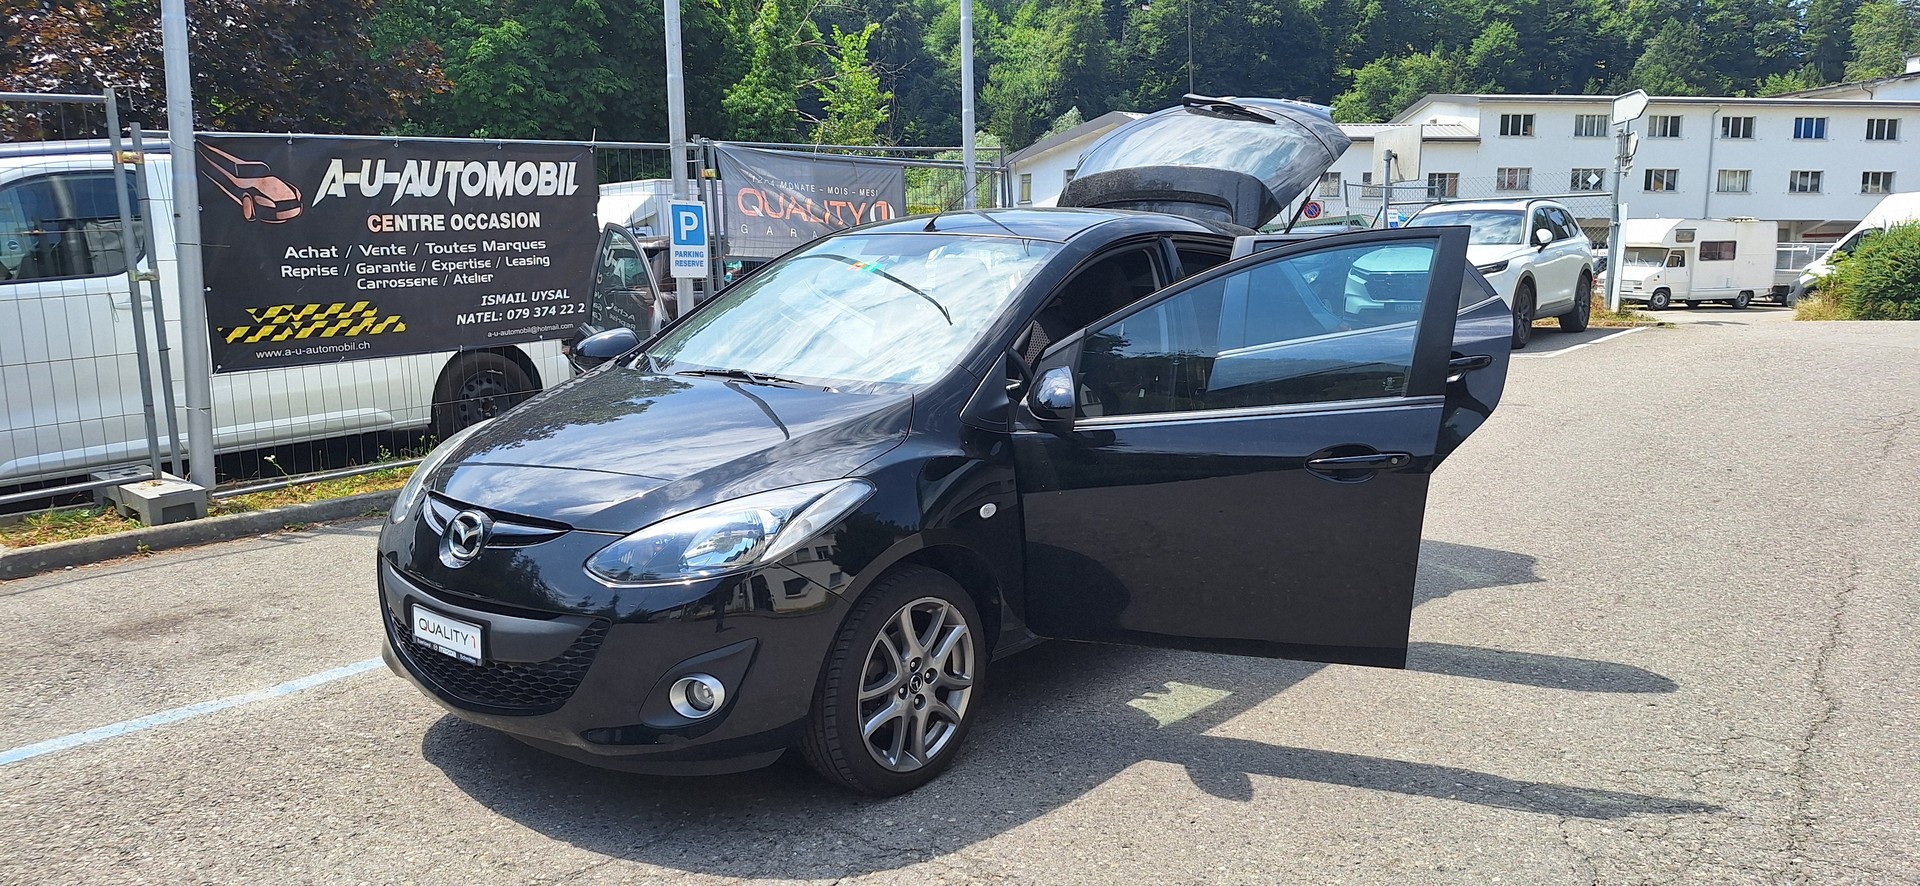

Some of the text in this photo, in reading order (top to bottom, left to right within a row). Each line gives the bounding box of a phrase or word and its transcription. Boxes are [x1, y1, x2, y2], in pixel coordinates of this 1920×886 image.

[311, 158, 579, 207] A-U-AUTOMOBIL
[779, 181, 815, 193] MONATE
[827, 186, 848, 195] MOIS
[859, 189, 878, 197] MESI
[737, 187, 867, 226] QUALITY
[367, 212, 540, 233] CENTRE OCCASION
[679, 211, 698, 240] P
[284, 240, 546, 259] Achat / Vente / Toutes Marques
[674, 250, 704, 258] PARKING
[280, 255, 550, 279] Reprise / Garantie / Expertise / Leasing
[357, 272, 494, 290] Carrosserie / Atelier
[480, 289, 570, 306] ISMAIL UYSAL
[456, 312, 503, 325] NATEL:
[506, 308, 530, 321] 079
[533, 306, 557, 318] 374
[559, 304, 574, 315] 22
[487, 322, 574, 338] a-u-automobil@hotmail.com
[256, 341, 370, 359] www.a-u-automobil.ch
[418, 618, 469, 645] QUALITY
[471, 635, 476, 648] 1
